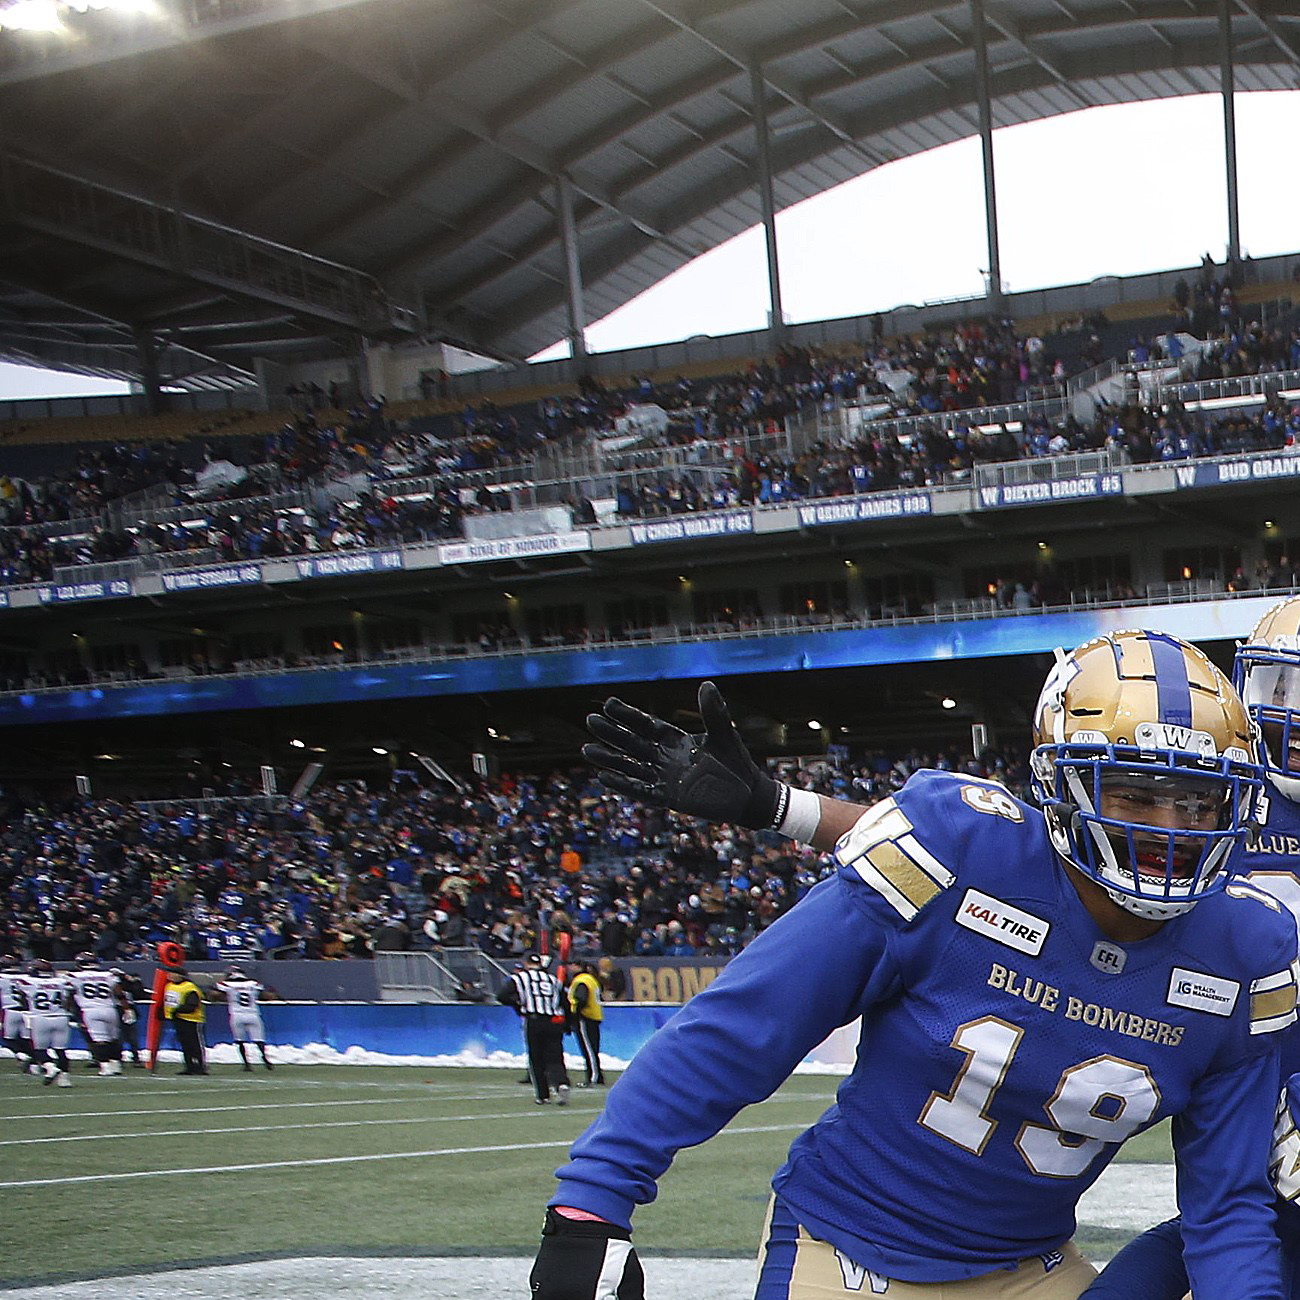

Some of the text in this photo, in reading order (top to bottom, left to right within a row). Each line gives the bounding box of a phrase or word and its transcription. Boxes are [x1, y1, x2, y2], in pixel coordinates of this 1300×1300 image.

[1218, 461, 1250, 481] BUD
[1003, 481, 1050, 502] DIETER
[1051, 478, 1097, 498] BROCK
[1101, 475, 1121, 494] #5
[858, 499, 901, 518] JAMES
[1162, 726, 1192, 748] W
[1097, 949, 1120, 969] CFL
[629, 966, 724, 1002] BOM
[1178, 981, 1193, 995] IG
[987, 963, 1186, 1048] BLUE BOMBERS
[917, 1014, 1161, 1180] 19
